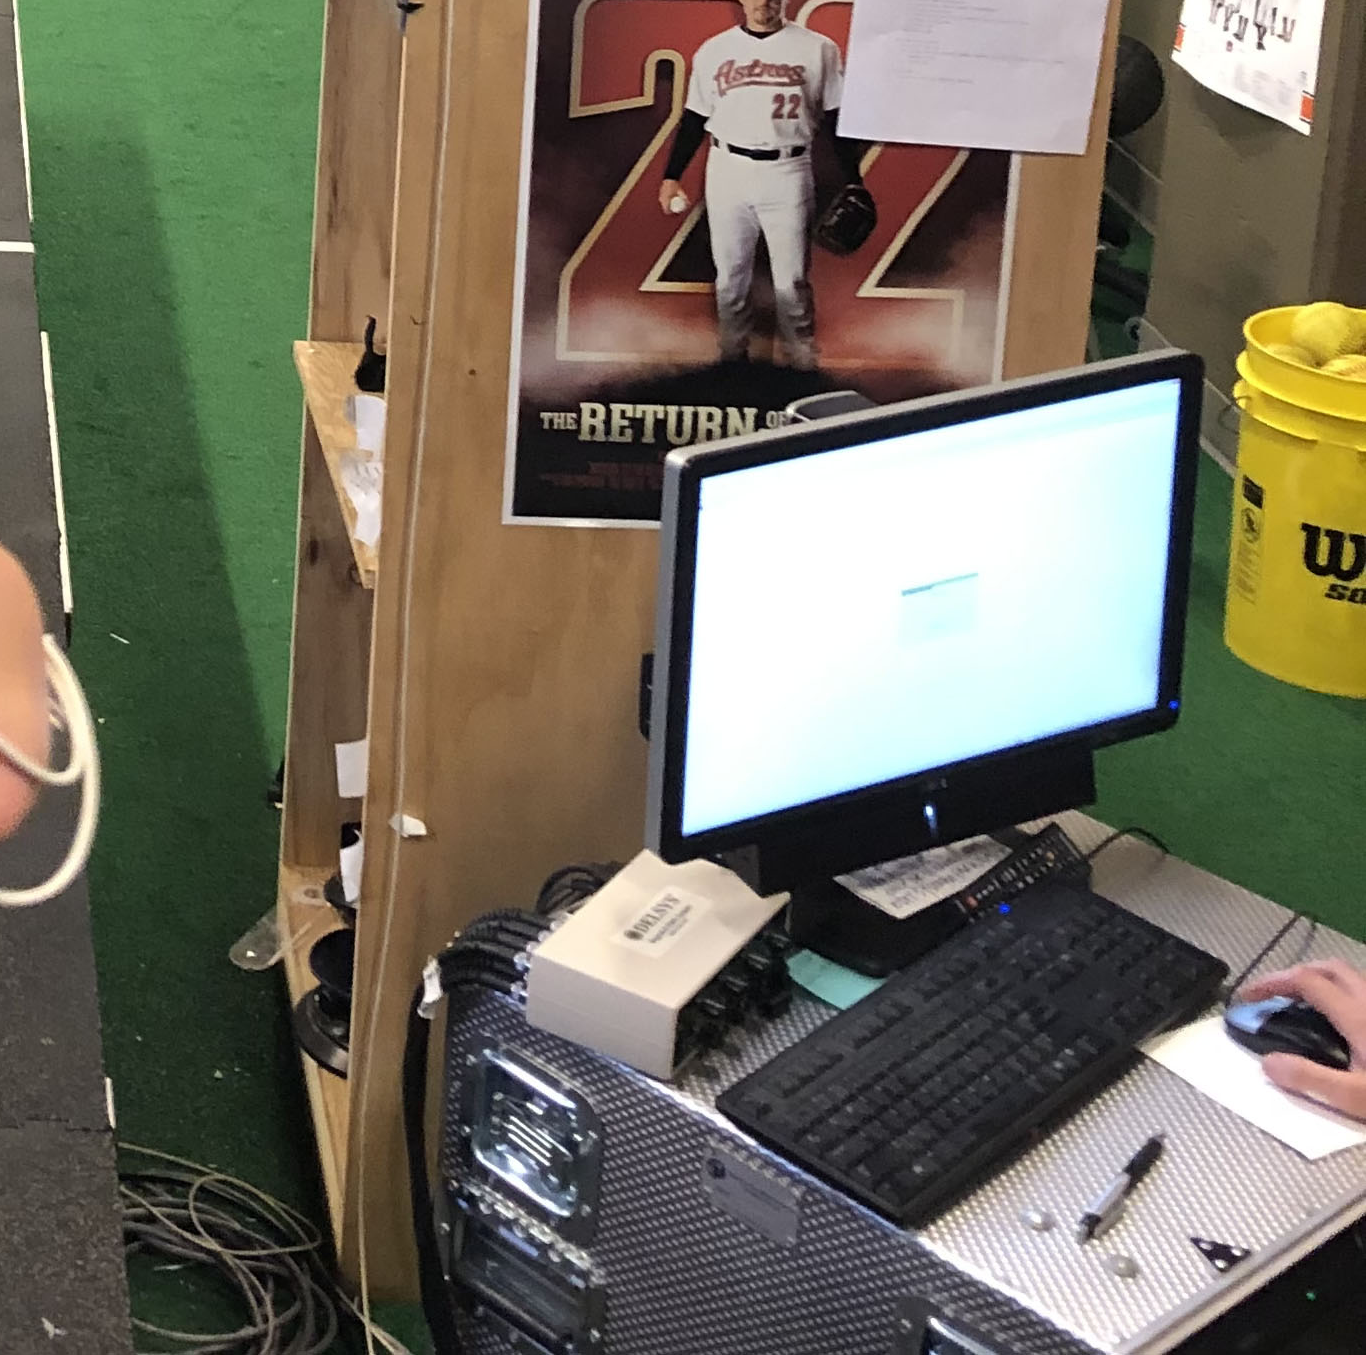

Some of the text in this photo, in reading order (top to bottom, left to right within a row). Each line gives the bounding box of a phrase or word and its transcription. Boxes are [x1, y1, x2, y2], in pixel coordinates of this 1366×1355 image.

[714, 59, 806, 98] Astros
[772, 92, 802, 120] 22
[539, 412, 578, 431] THE
[578, 402, 759, 445] RETURN
